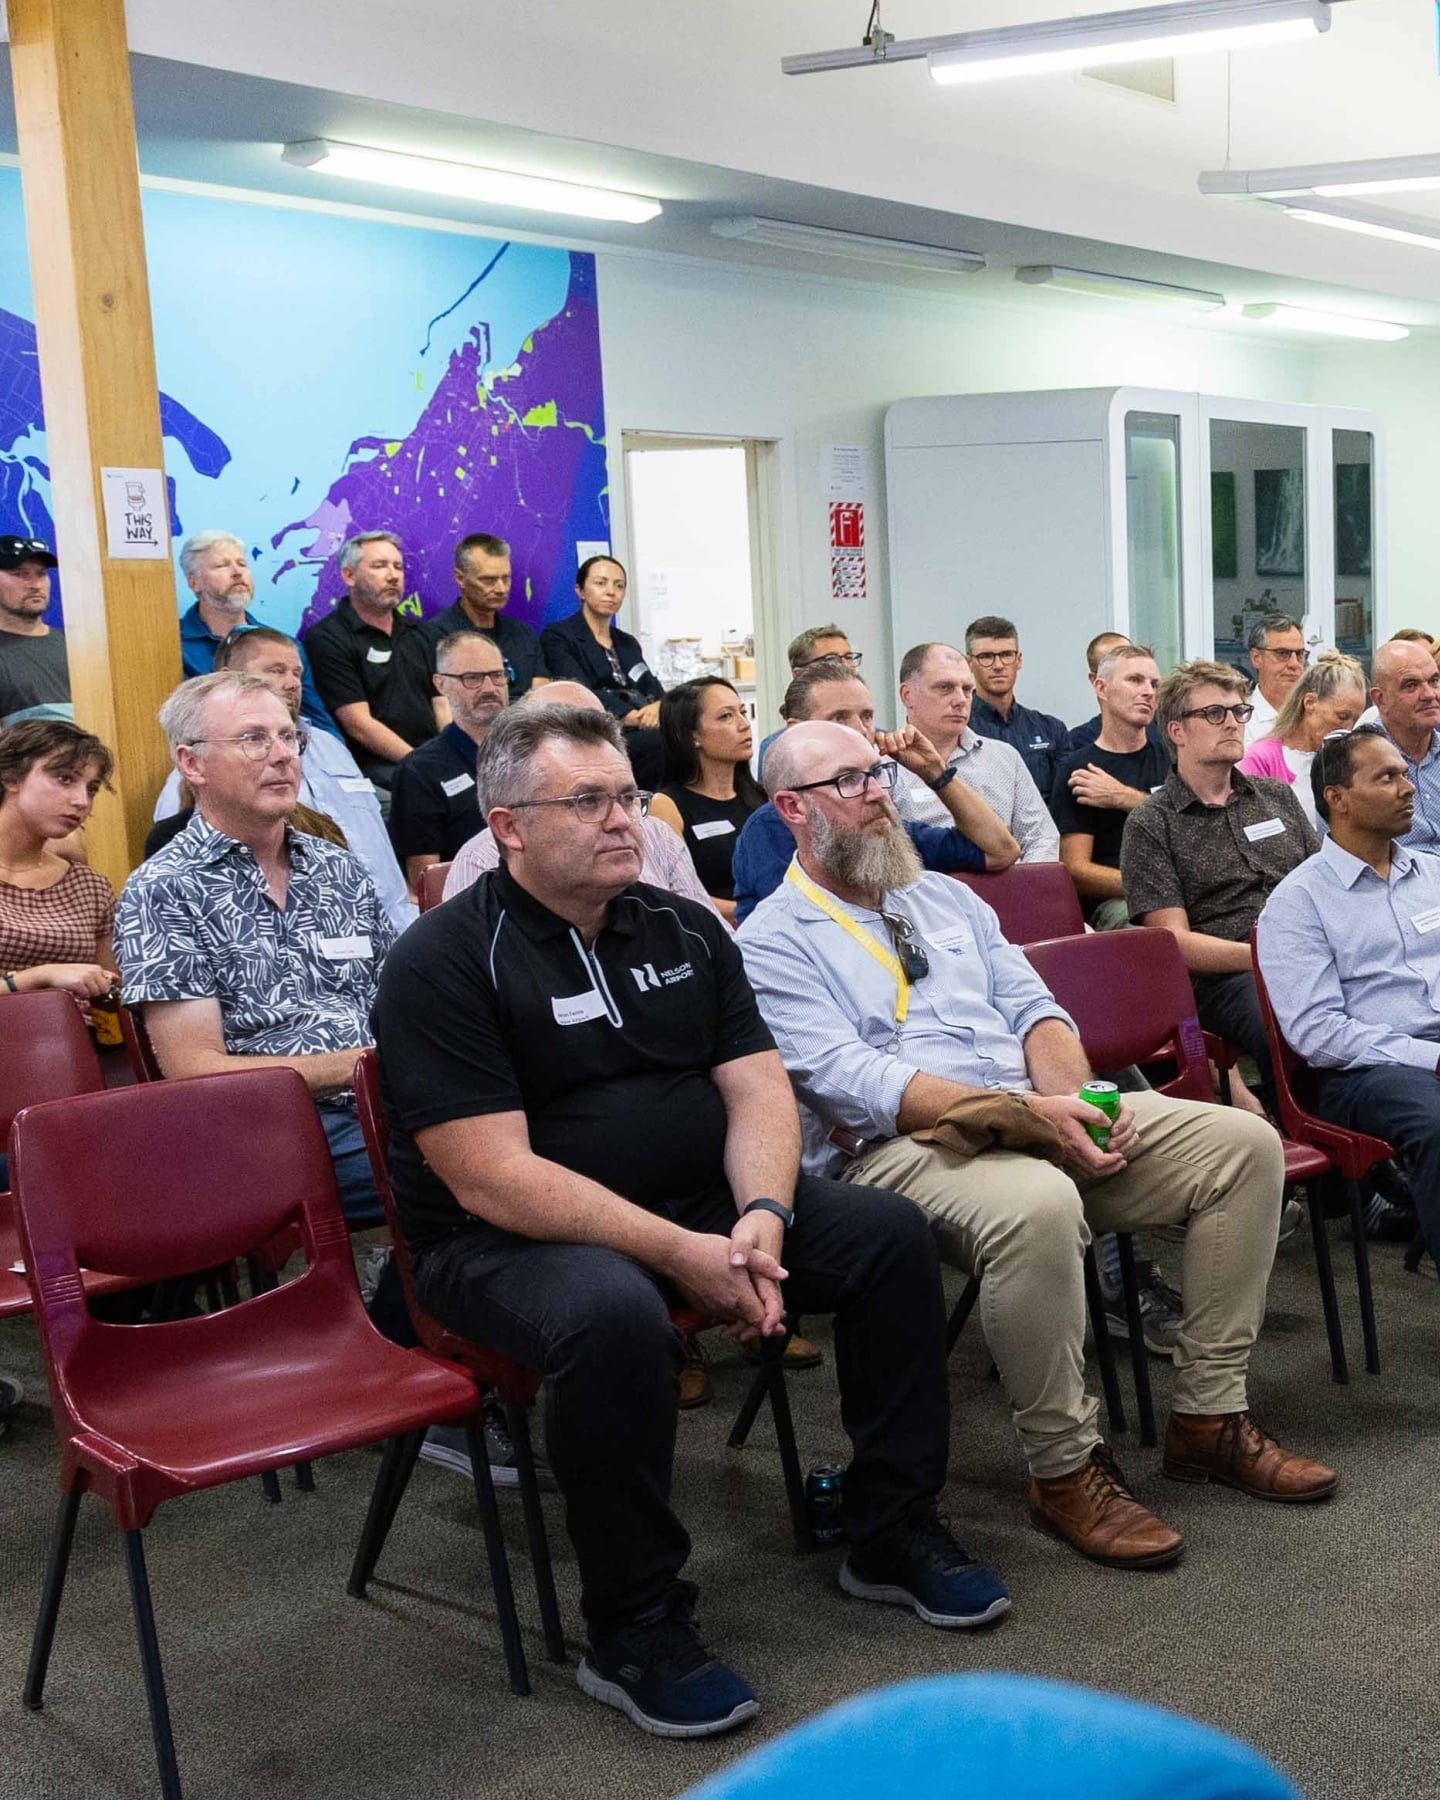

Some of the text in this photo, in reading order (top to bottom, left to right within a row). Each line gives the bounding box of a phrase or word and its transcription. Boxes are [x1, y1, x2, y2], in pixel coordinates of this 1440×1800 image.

[124, 512, 152, 527] THIS
[126, 526, 153, 540] WAY
[660, 961, 692, 978] NELSON
